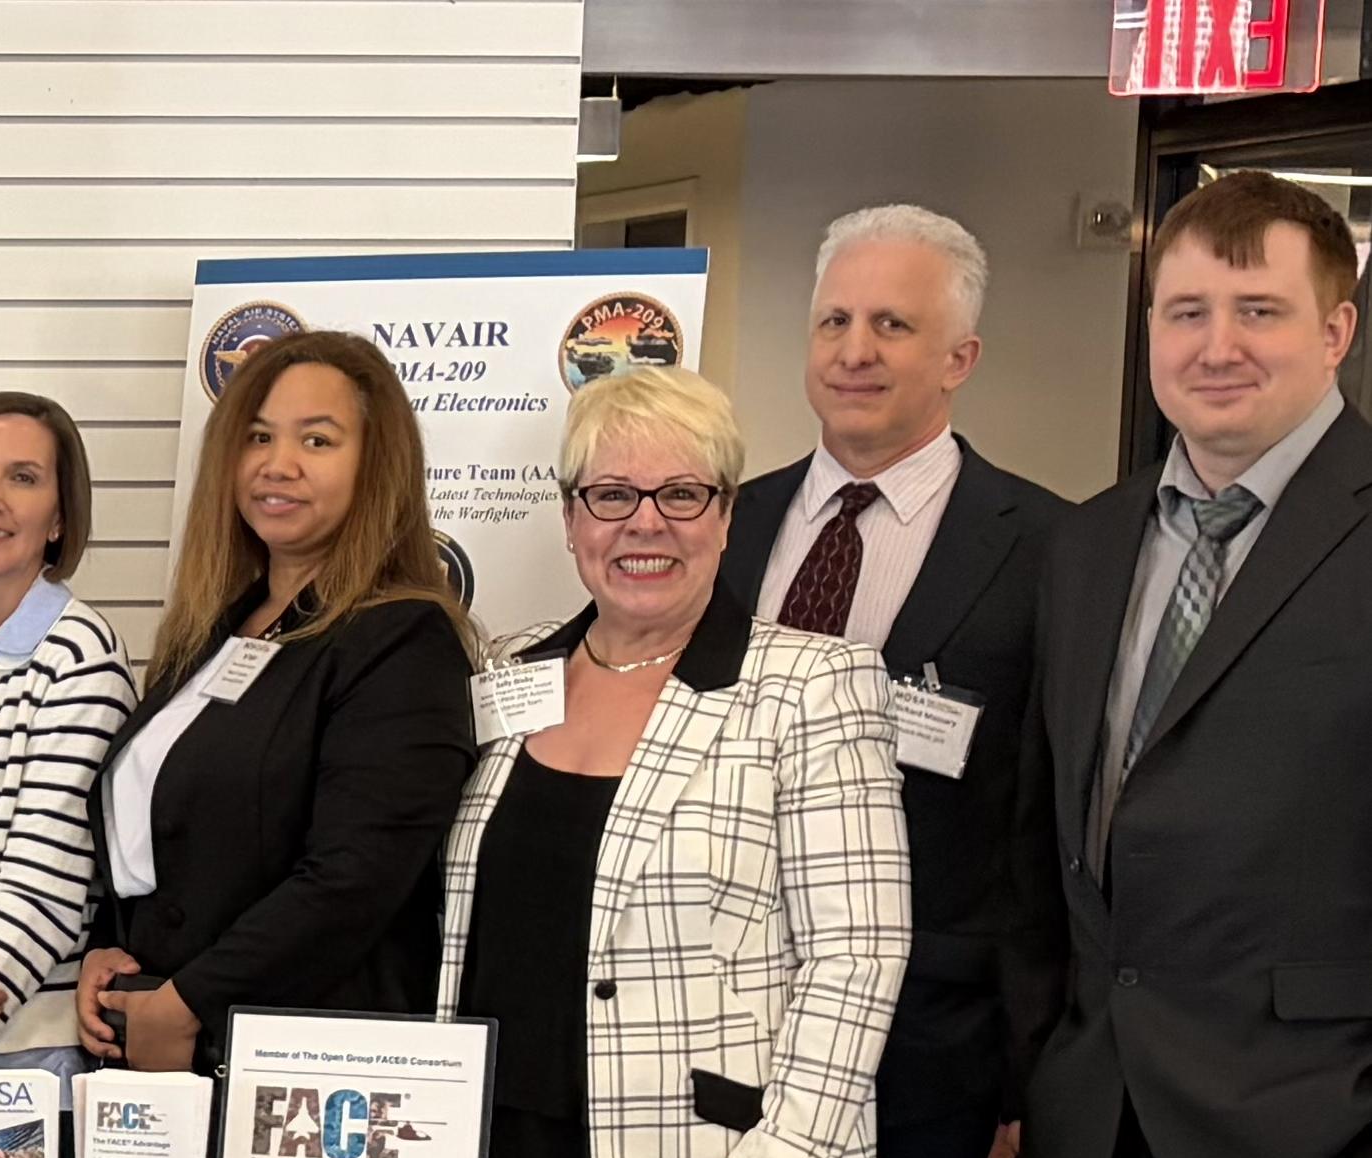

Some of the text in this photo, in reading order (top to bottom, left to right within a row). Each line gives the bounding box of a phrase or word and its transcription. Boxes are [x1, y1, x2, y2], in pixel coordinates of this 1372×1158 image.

[582, 302, 665, 335] PMA-209
[373, 321, 510, 348] NAVAIR
[433, 393, 548, 412] Electronics
[468, 464, 516, 481] Team
[430, 488, 559, 504] Latest Technologies
[434, 507, 528, 523] the Warfighter
[255, 1049, 289, 1060] Member
[291, 1050, 301, 1060] of
[303, 1051, 319, 1061] The
[320, 1052, 344, 1063] Open
[346, 1053, 374, 1065] Group
